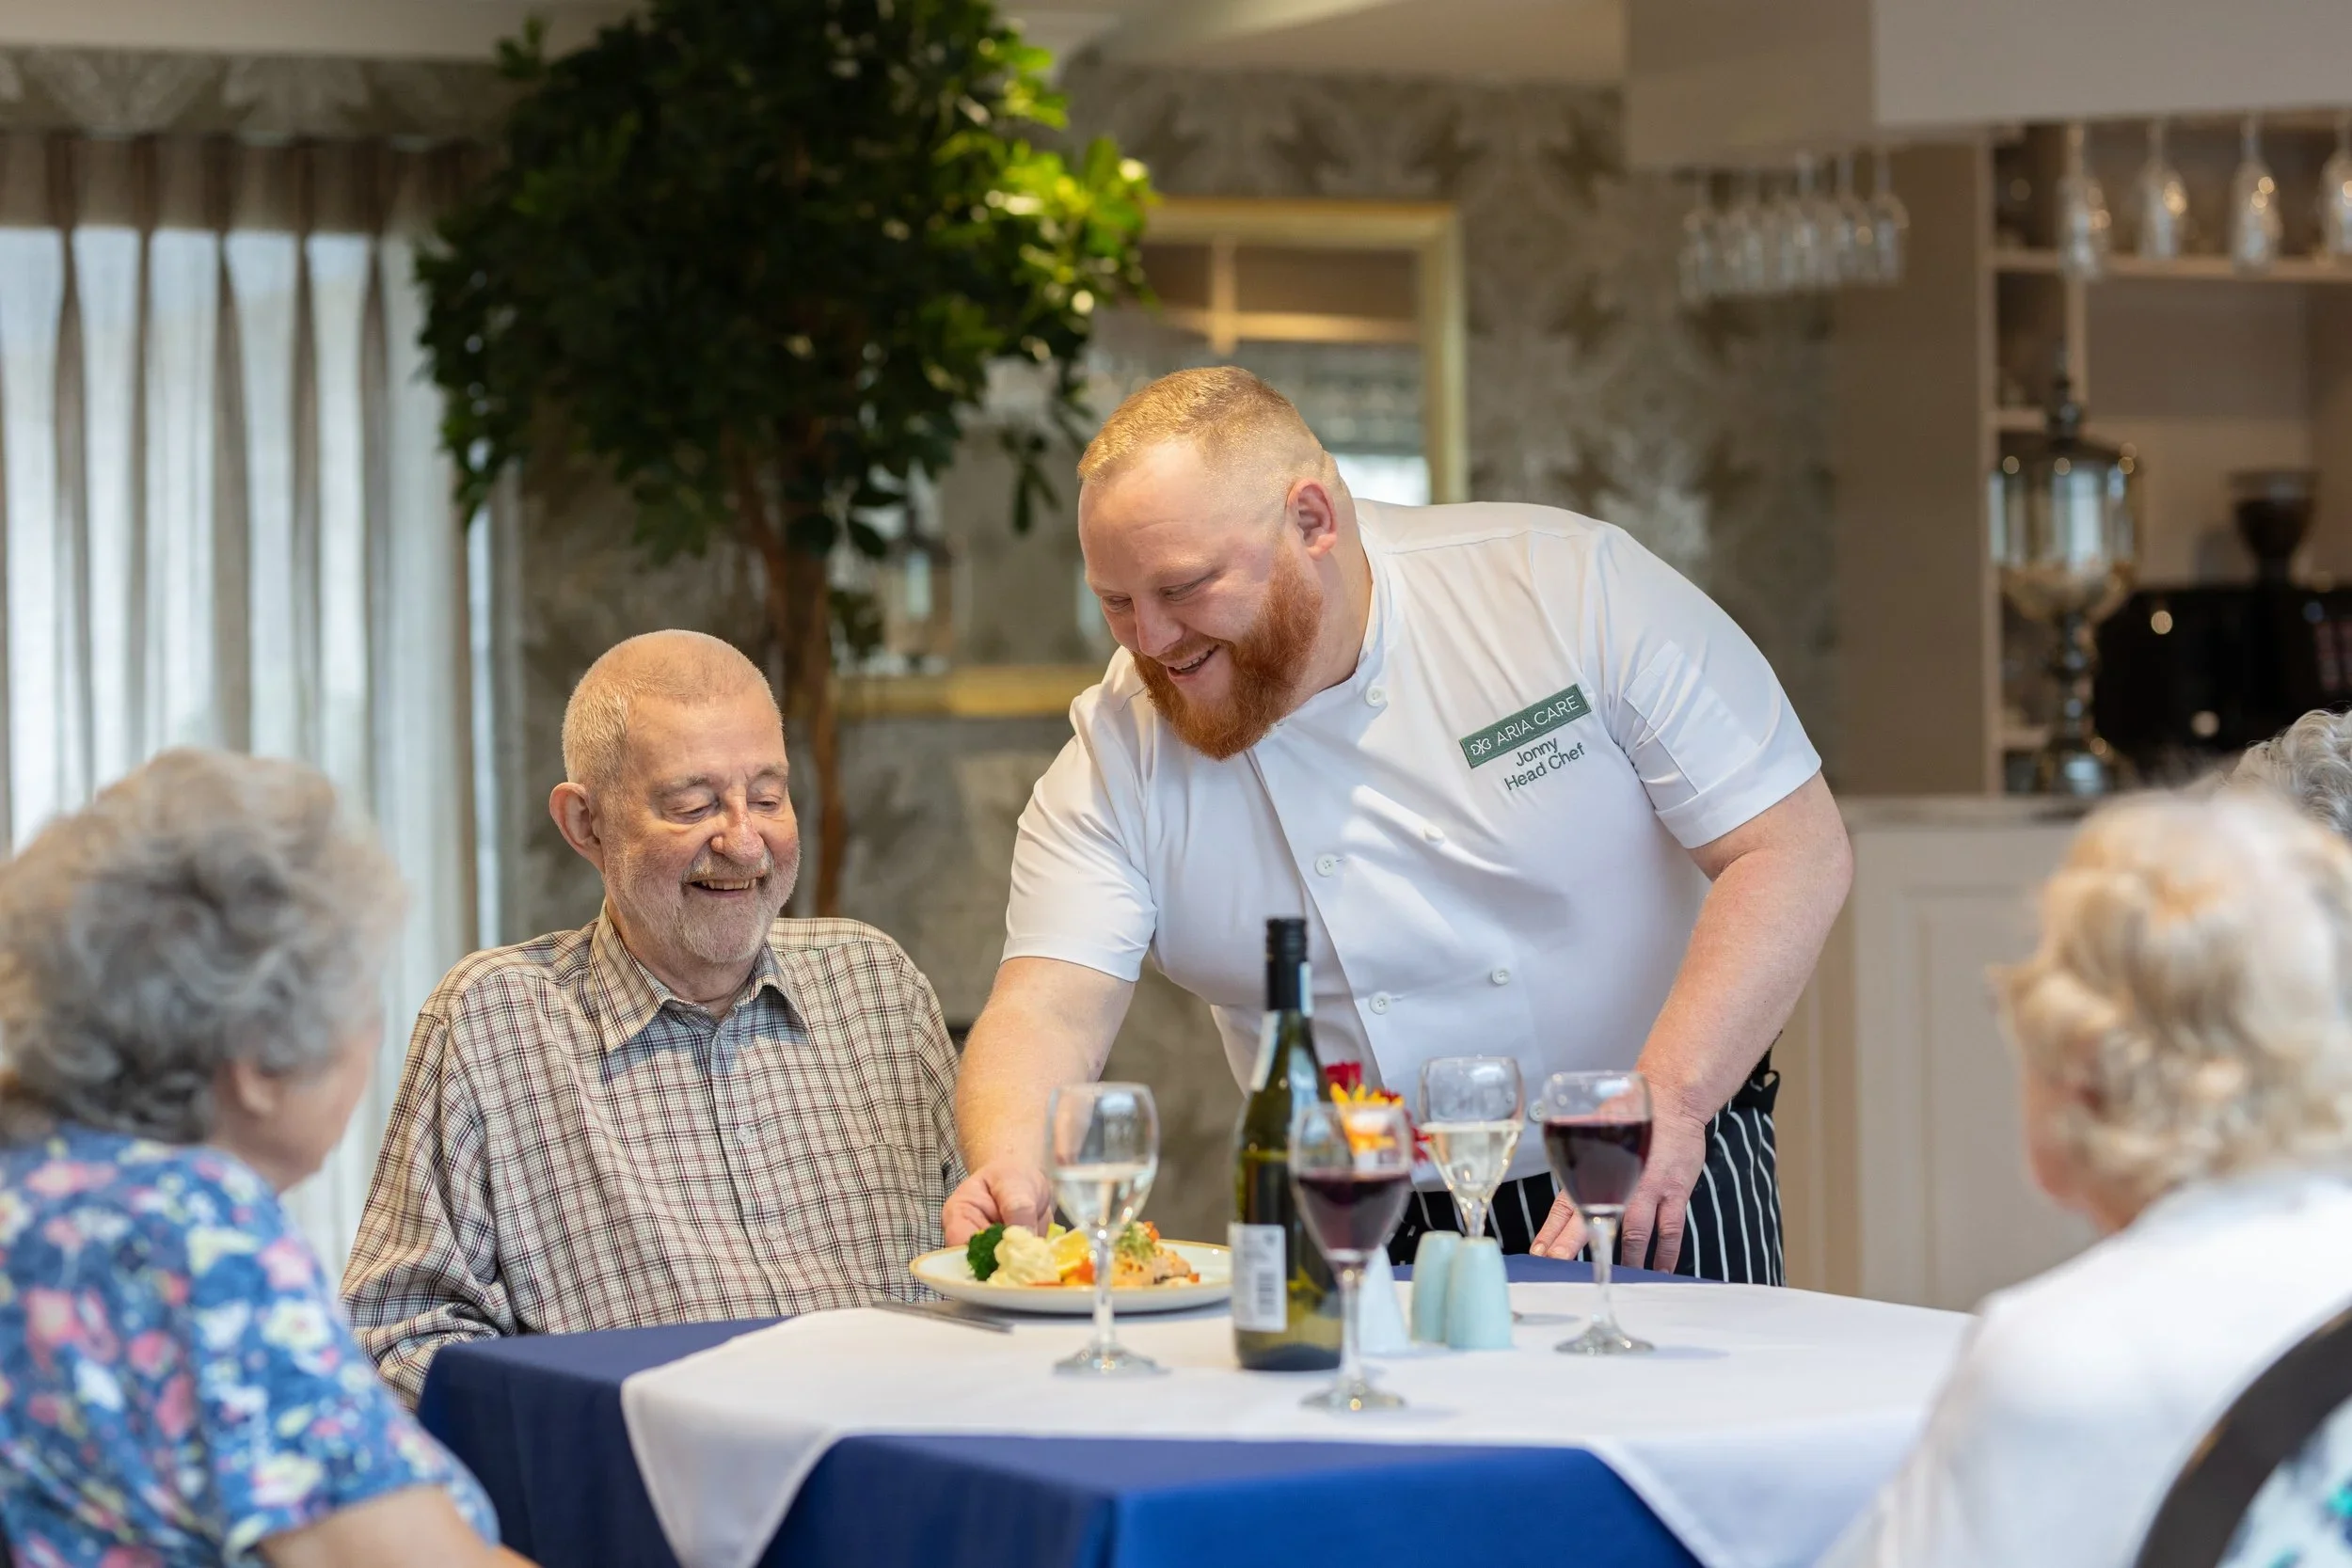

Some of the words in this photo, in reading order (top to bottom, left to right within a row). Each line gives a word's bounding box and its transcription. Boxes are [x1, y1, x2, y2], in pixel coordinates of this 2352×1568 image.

[1497, 719, 1534, 746] ARIA
[1534, 695, 1580, 725] CARE
[1503, 762, 1548, 791] Head
[1548, 742, 1585, 769] Chef
[1516, 737, 1559, 767] Jonny
